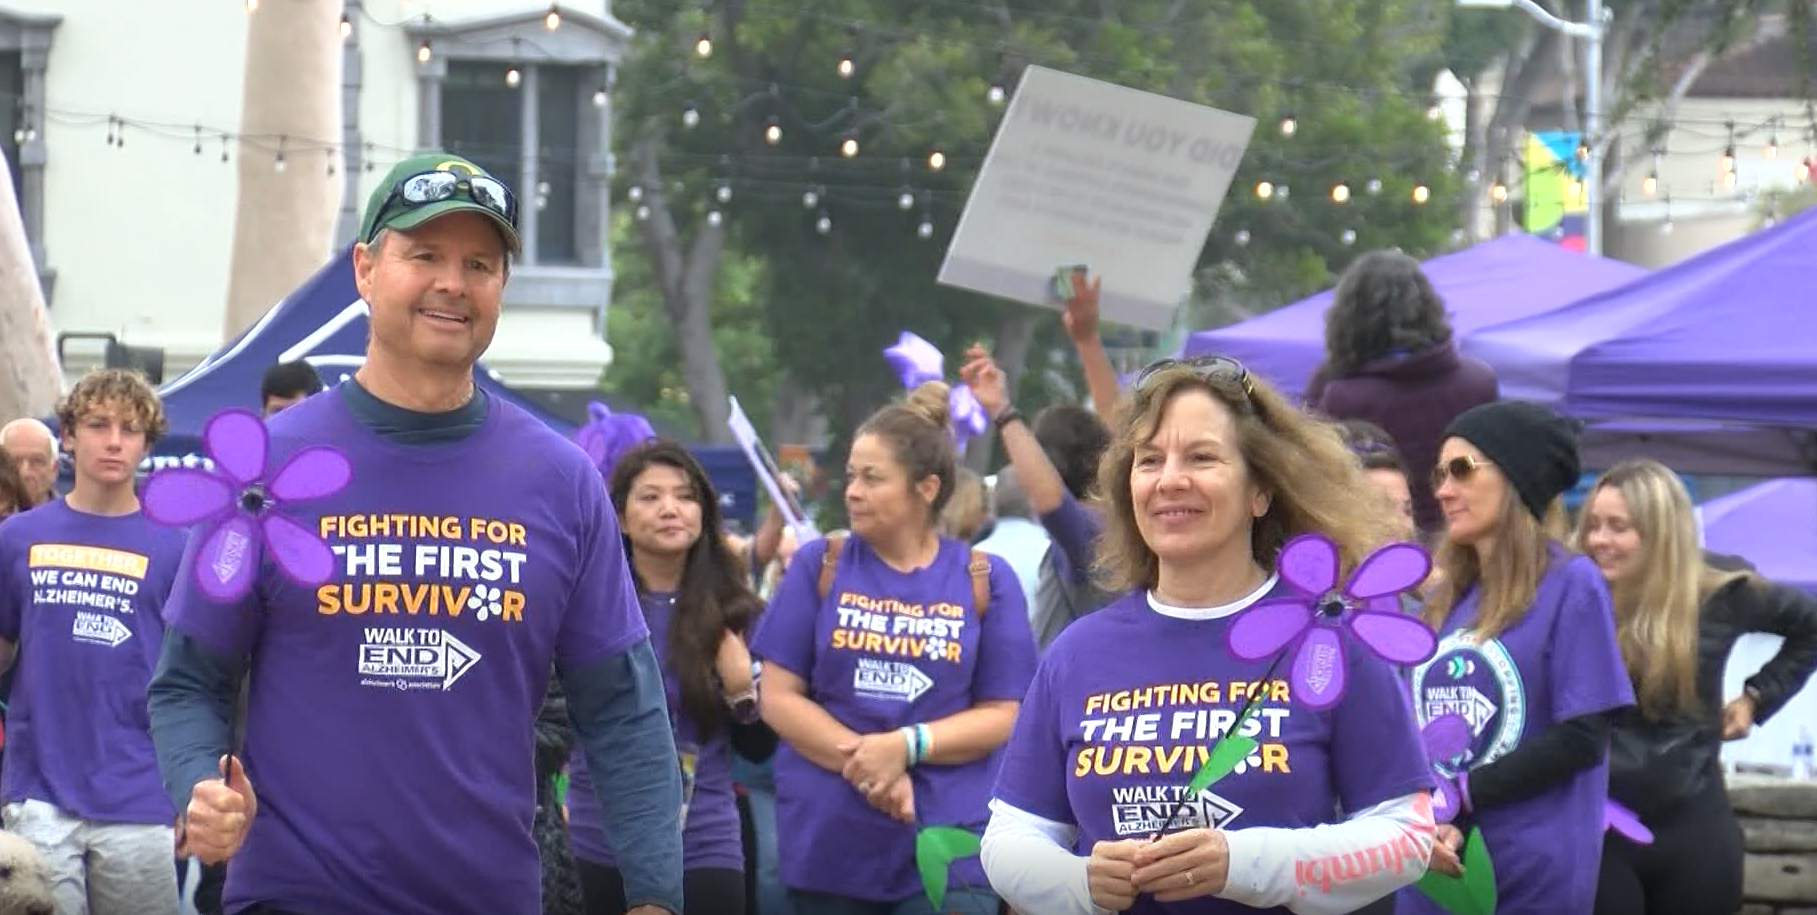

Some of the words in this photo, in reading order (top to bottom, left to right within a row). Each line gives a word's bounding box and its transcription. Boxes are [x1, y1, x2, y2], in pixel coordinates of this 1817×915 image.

[319, 514, 462, 540] FIGHTING
[470, 517, 527, 546] FOR
[414, 545, 527, 583] FIRST
[30, 570, 60, 586] WE
[61, 571, 98, 588] CAN
[100, 575, 139, 595] END
[840, 592, 924, 617] FIGHTING
[928, 602, 964, 618] FOR
[837, 606, 888, 633] THE
[892, 615, 965, 639] FIRST
[364, 627, 415, 644] WALK
[417, 628, 440, 645] TO
[363, 647, 440, 665] END
[362, 664, 440, 676] ALZHEIMER'S
[1086, 682, 1220, 715] FIGHTING
[1229, 680, 1290, 702] FOR
[1427, 686, 1458, 700] WALK
[1080, 713, 1161, 741] THE
[1170, 708, 1290, 740] FIRST
[1113, 786, 1168, 803] WALK
[1117, 803, 1197, 824] END
